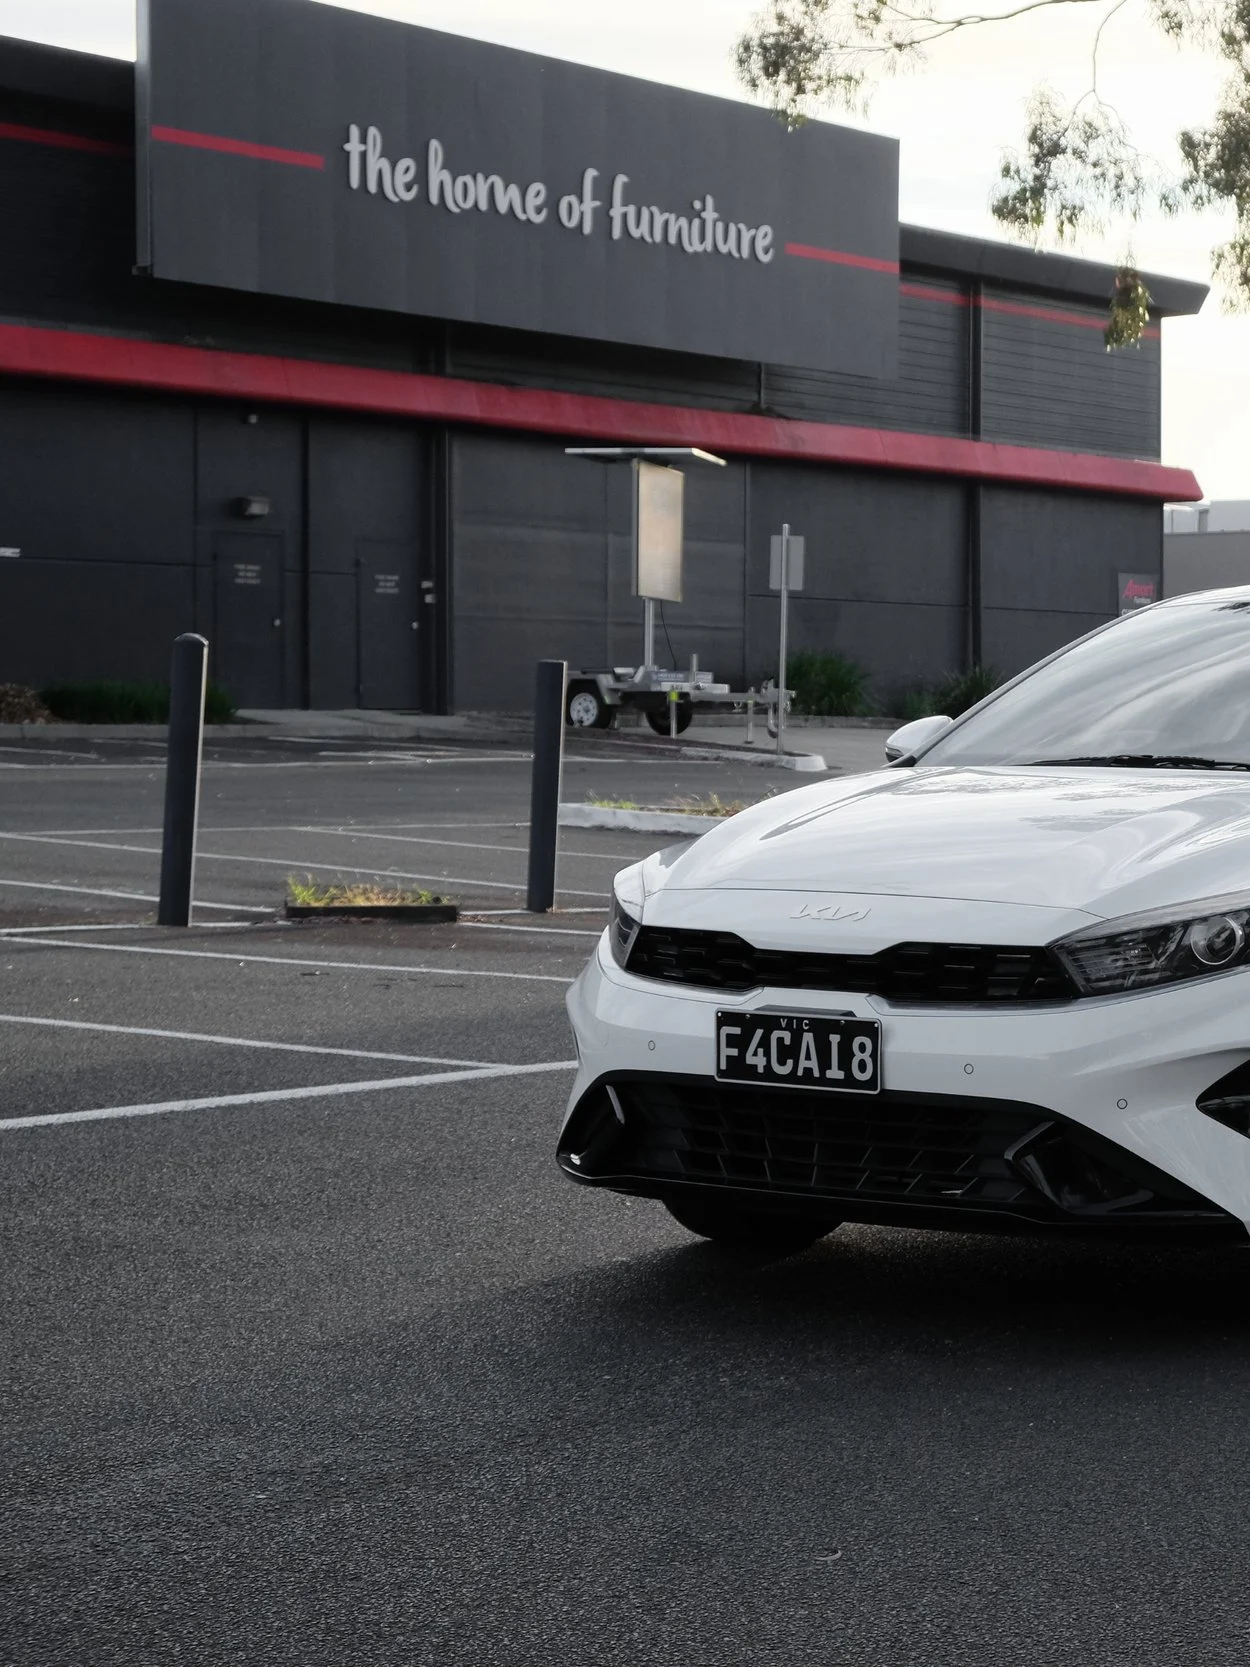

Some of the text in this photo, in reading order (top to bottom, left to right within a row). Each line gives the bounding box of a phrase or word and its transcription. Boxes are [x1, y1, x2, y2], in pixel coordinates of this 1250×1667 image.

[343, 124, 775, 263] the home of furniture
[780, 1018, 810, 1030] VIC
[719, 1026, 874, 1081] F4CAI8
